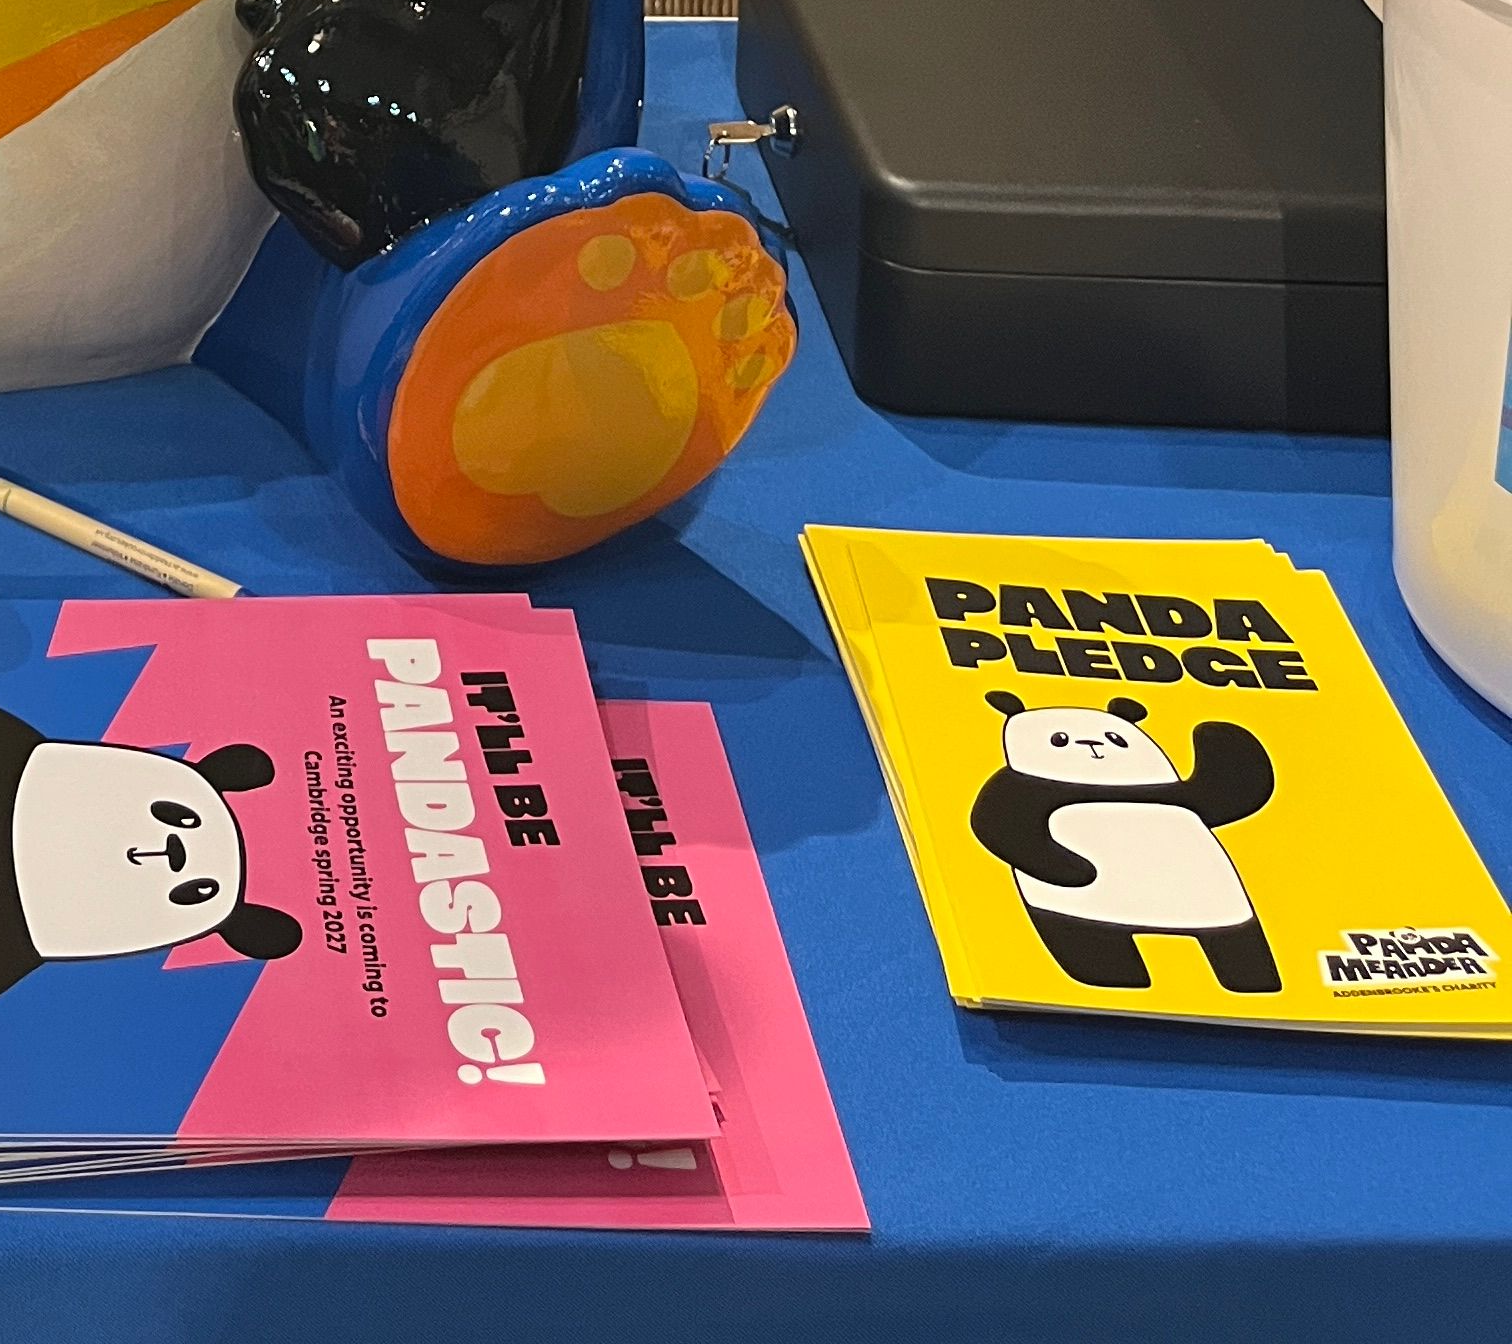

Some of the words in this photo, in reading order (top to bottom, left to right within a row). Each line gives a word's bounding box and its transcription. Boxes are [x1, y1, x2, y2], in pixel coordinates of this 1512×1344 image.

[925, 577, 1295, 644] PANDA
[940, 627, 1319, 691] PLEDGE
[329, 695, 347, 718] An
[460, 671, 533, 775] IT'LL
[332, 722, 357, 789] exciting
[304, 750, 331, 845] Cambridge
[492, 783, 560, 847] BE
[311, 849, 340, 906] spring
[337, 793, 374, 901] opportunity
[367, 638, 546, 1085] PANDASTIC!
[356, 906, 378, 919] is
[640, 865, 707, 926] BE
[323, 910, 347, 953] 2027
[359, 923, 386, 992] coming
[1347, 932, 1489, 960] PANDA
[1326, 955, 1487, 981] MEANDER
[370, 997, 389, 1017] to
